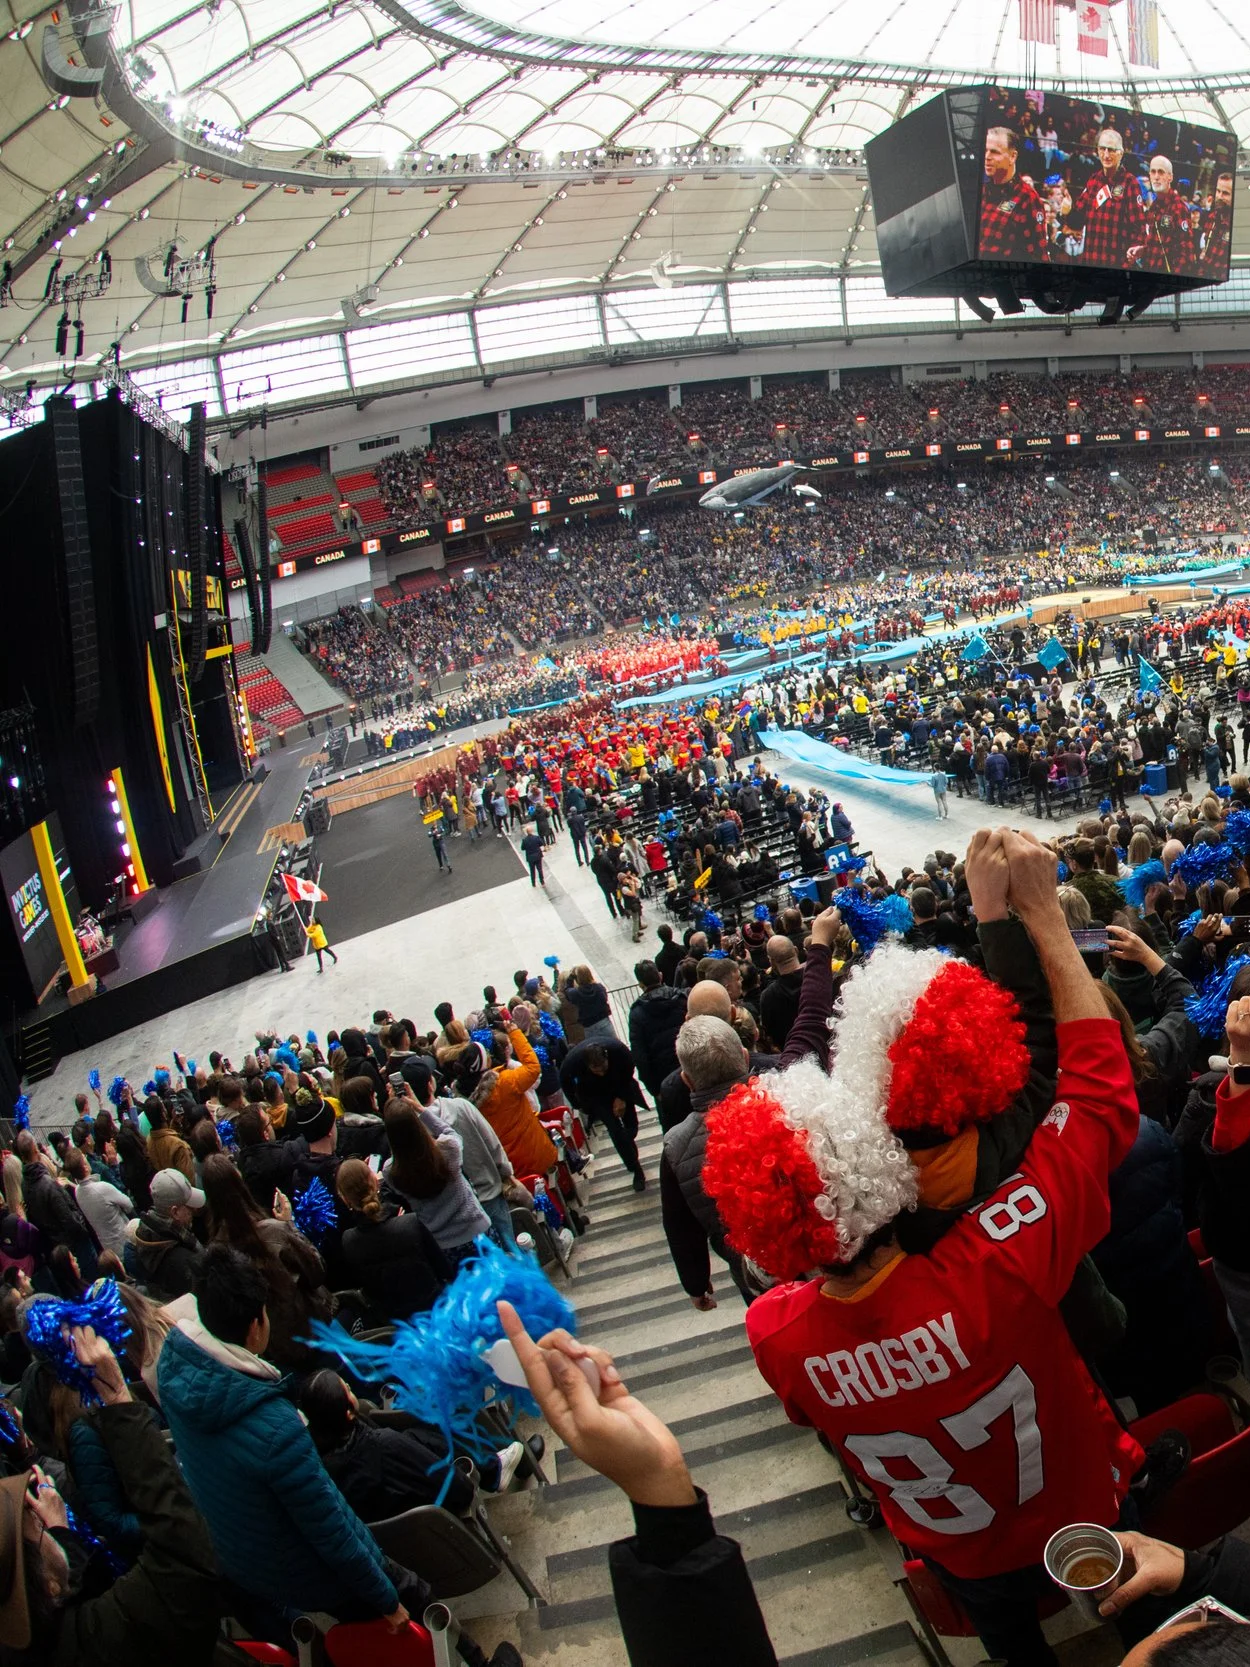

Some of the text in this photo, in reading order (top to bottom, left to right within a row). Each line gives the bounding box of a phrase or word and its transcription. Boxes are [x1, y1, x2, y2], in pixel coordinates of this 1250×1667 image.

[1096, 434, 1121, 442] CANADA
[886, 450, 911, 459] CANADA
[957, 444, 982, 452] CANADA
[812, 457, 839, 467] CANADA
[568, 493, 600, 505] CANADA
[484, 508, 515, 523] CANADA
[399, 529, 430, 543] CANADA
[315, 551, 345, 565] CANADA
[231, 573, 261, 589] CANA
[827, 851, 848, 870] A1
[803, 1311, 971, 1408] CROSBY
[844, 1363, 1044, 1535] 87
